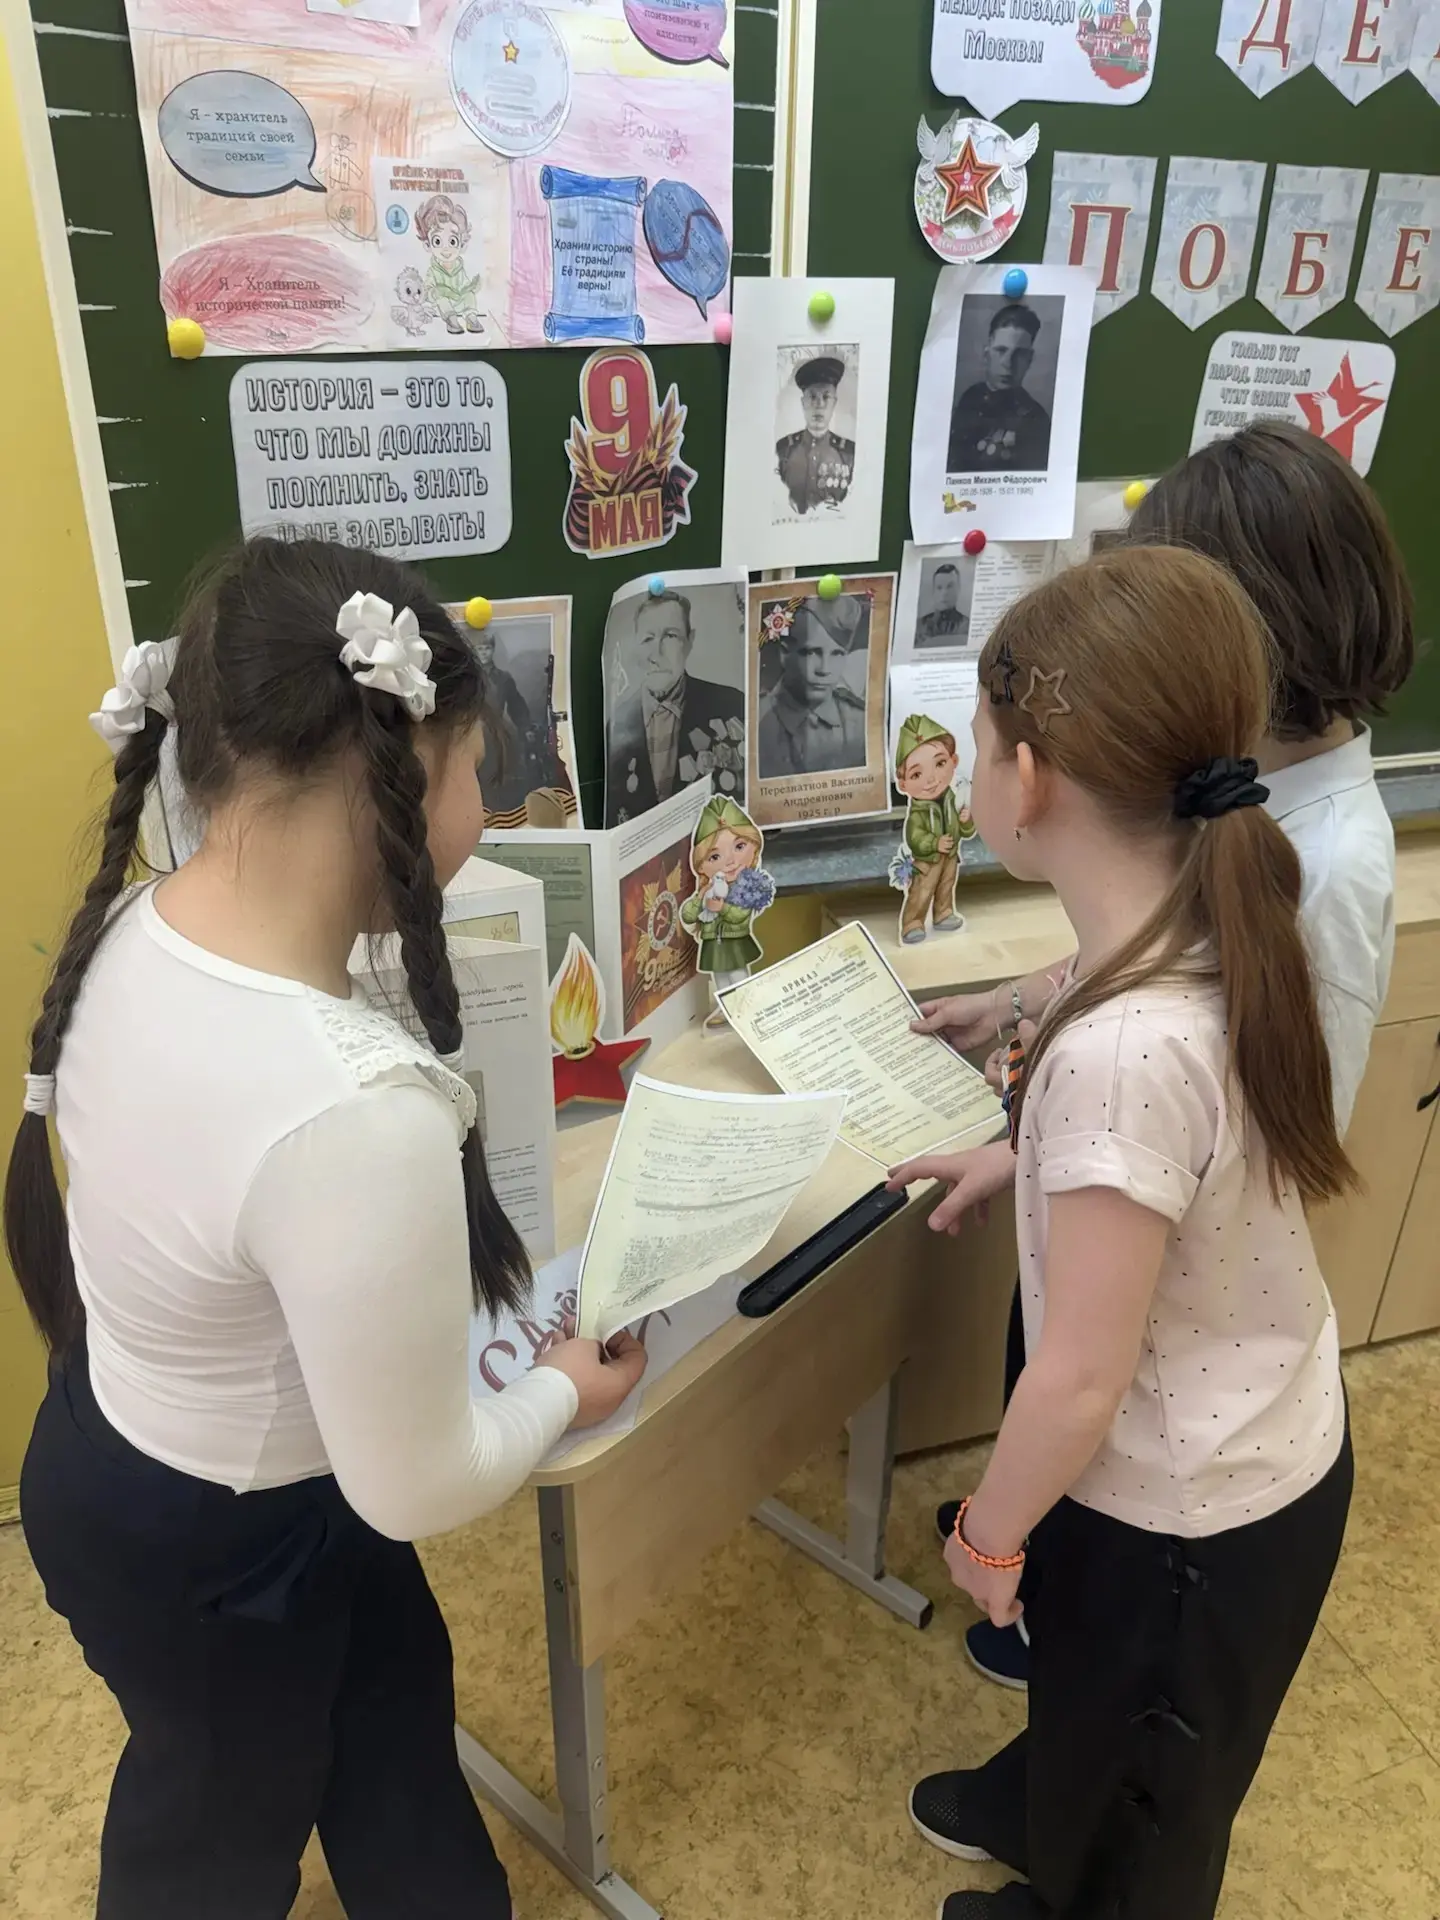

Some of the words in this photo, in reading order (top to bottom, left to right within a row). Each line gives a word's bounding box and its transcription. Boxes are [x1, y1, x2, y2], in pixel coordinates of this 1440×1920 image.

[1009, 0, 1075, 26] ПОЗАДИ
[190, 109, 200, 122] Я
[216, 111, 287, 125] хранитель
[186, 130, 256, 144] традиций
[259, 132, 295, 144] своей
[225, 152, 265, 162] семьи
[963, 171, 972, 184] 9
[554, 239, 591, 252] Храним
[592, 243, 632, 254] историю
[575, 255, 614, 266] страны!
[561, 265, 573, 276] Её
[575, 269, 626, 280] традициям
[219, 277, 229, 291] Я
[246, 277, 320, 292] Хранитель
[577, 279, 611, 292] верны!
[196, 299, 289, 313] исторической
[294, 296, 345, 311] памяти!
[1231, 341, 1277, 361] ТОЛЬКО
[1279, 345, 1300, 363] ТОТ
[1253, 367, 1311, 387] КОТОРЫЙ
[245, 378, 374, 412] ИСТОРИЯ
[405, 377, 450, 408] ЭТО
[456, 376, 493, 409] ТО,
[1220, 387, 1250, 405] ЧТИТ
[1250, 389, 1291, 408] СВОИХ
[586, 353, 652, 476] 9
[254, 429, 308, 461] ЧТО
[316, 426, 370, 459] МЫ
[377, 422, 491, 461] ДОЛЖНЫ
[266, 473, 408, 509] ПОМНИТЬ,
[414, 467, 488, 500] ЗНАТЬ
[974, 476, 1001, 485] Михаил
[1003, 475, 1047, 486] Фёдорович
[590, 490, 662, 551] МАЯ
[346, 511, 485, 549] ЗАБЫВАТЬ!
[831, 774, 875, 787] Василий
[798, 810, 821, 820] 1925
[782, 970, 818, 993] ПРИКАЗ
